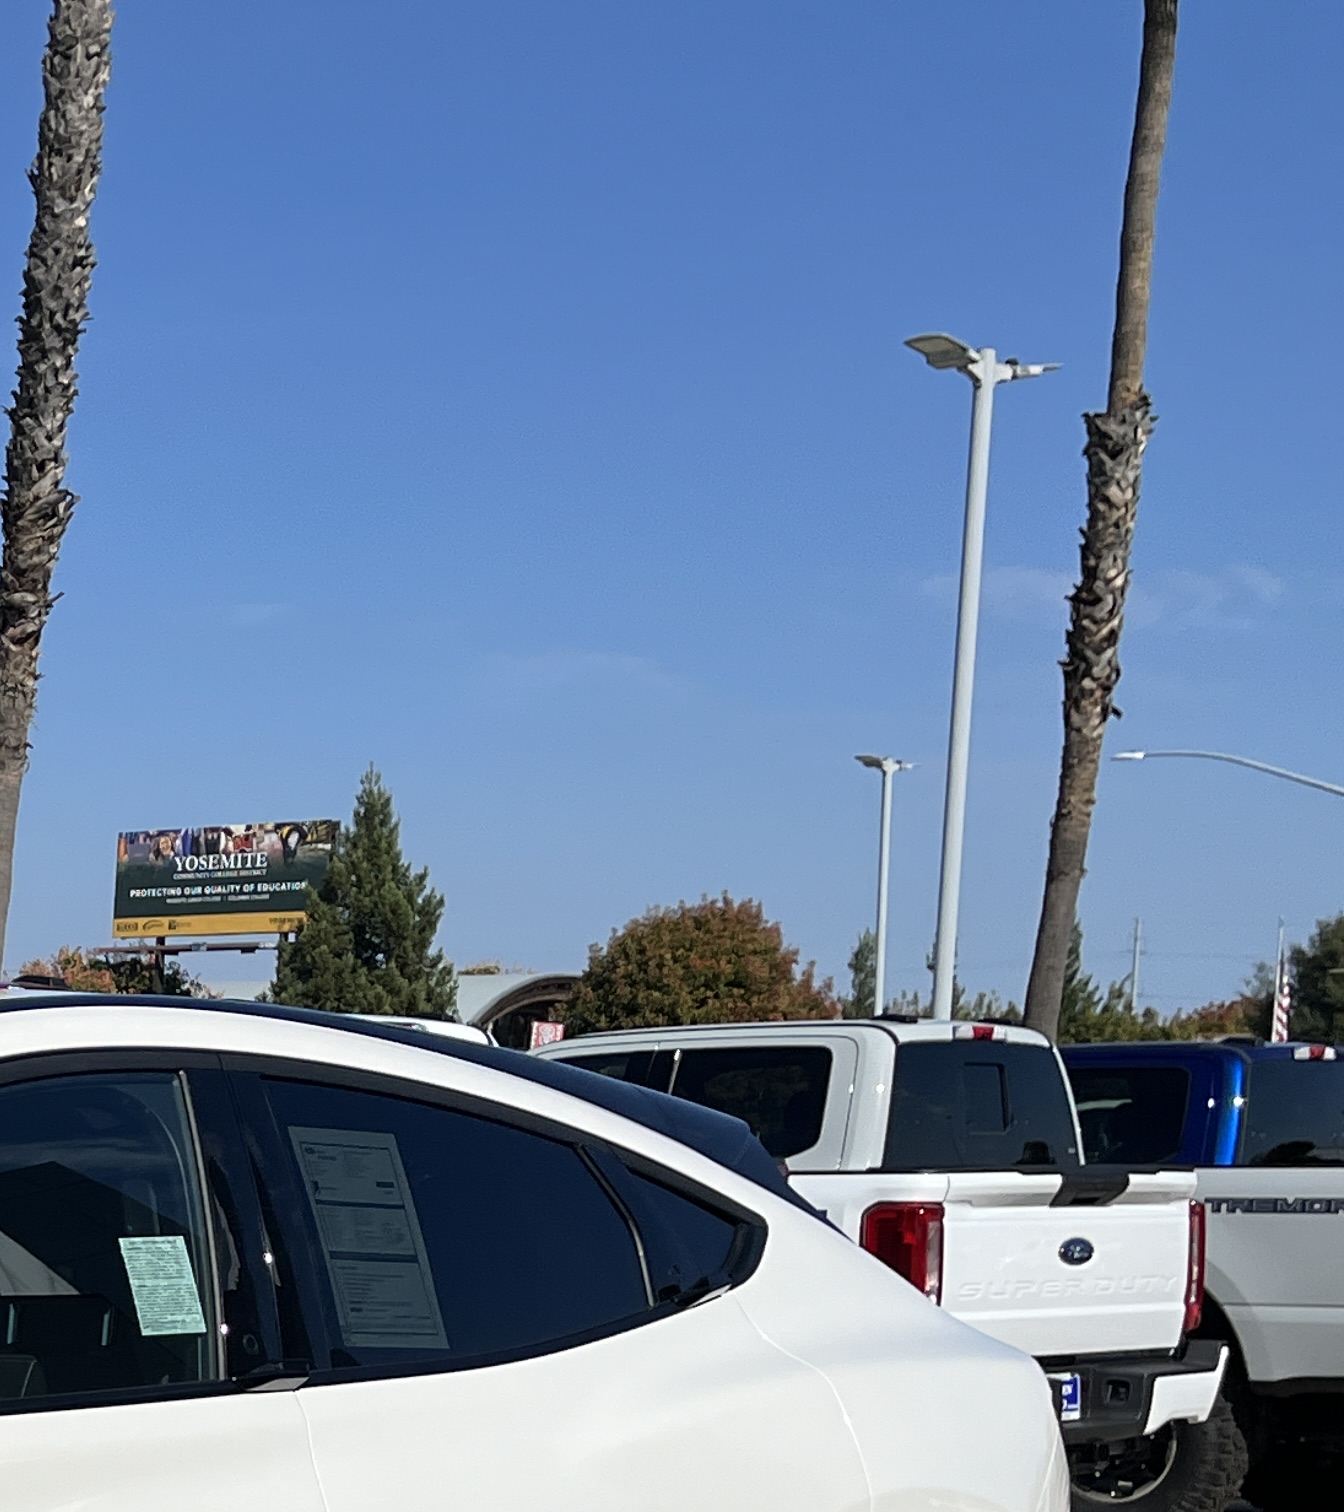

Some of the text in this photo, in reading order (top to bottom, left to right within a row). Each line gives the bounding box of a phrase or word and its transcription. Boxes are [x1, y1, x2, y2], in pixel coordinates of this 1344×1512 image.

[174, 852, 268, 872] YOSEMITE
[130, 887, 182, 898] PROTECTING
[184, 886, 203, 895] OUR
[204, 884, 241, 894] QUALITY
[243, 883, 255, 892] OF
[1204, 1197, 1344, 1214] TREMOR
[958, 1274, 1178, 1301] SUPER DUTY
